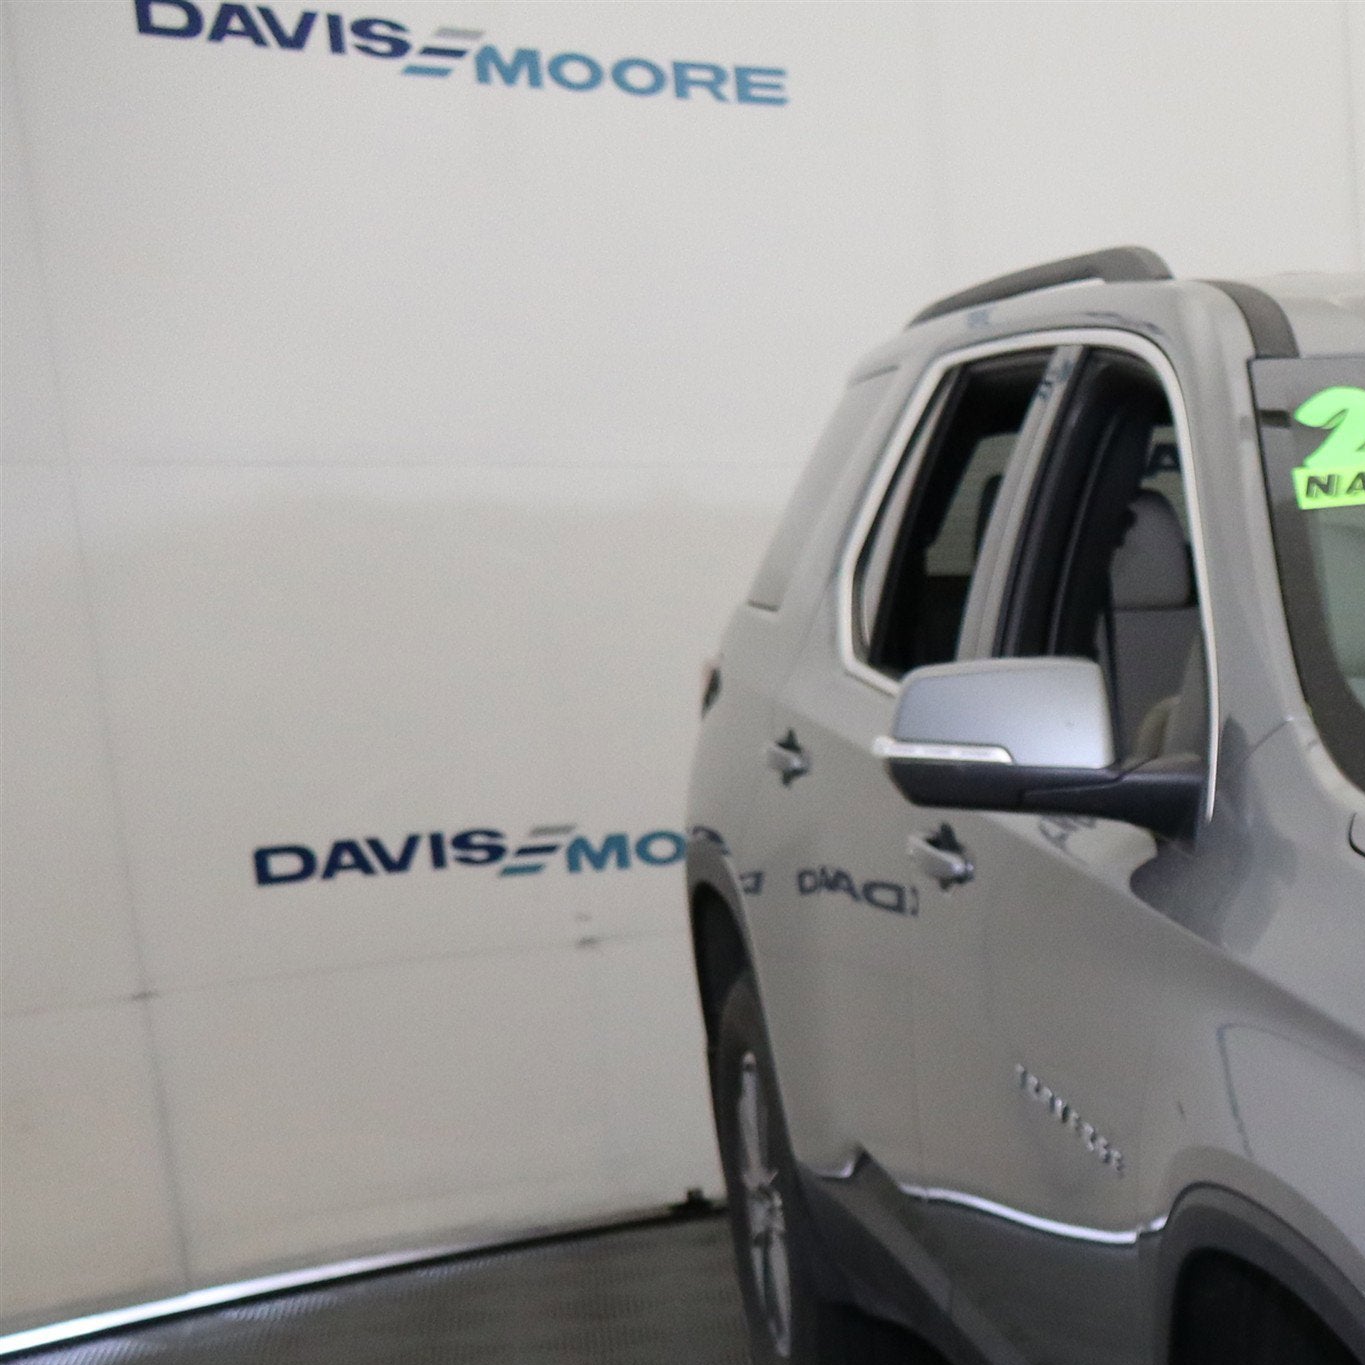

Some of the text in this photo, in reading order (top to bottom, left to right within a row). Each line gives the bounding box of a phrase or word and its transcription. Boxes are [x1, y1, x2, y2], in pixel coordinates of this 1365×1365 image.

[131, 0, 789, 107] DAVIS MOORE
[251, 827, 511, 889] DAVIS
